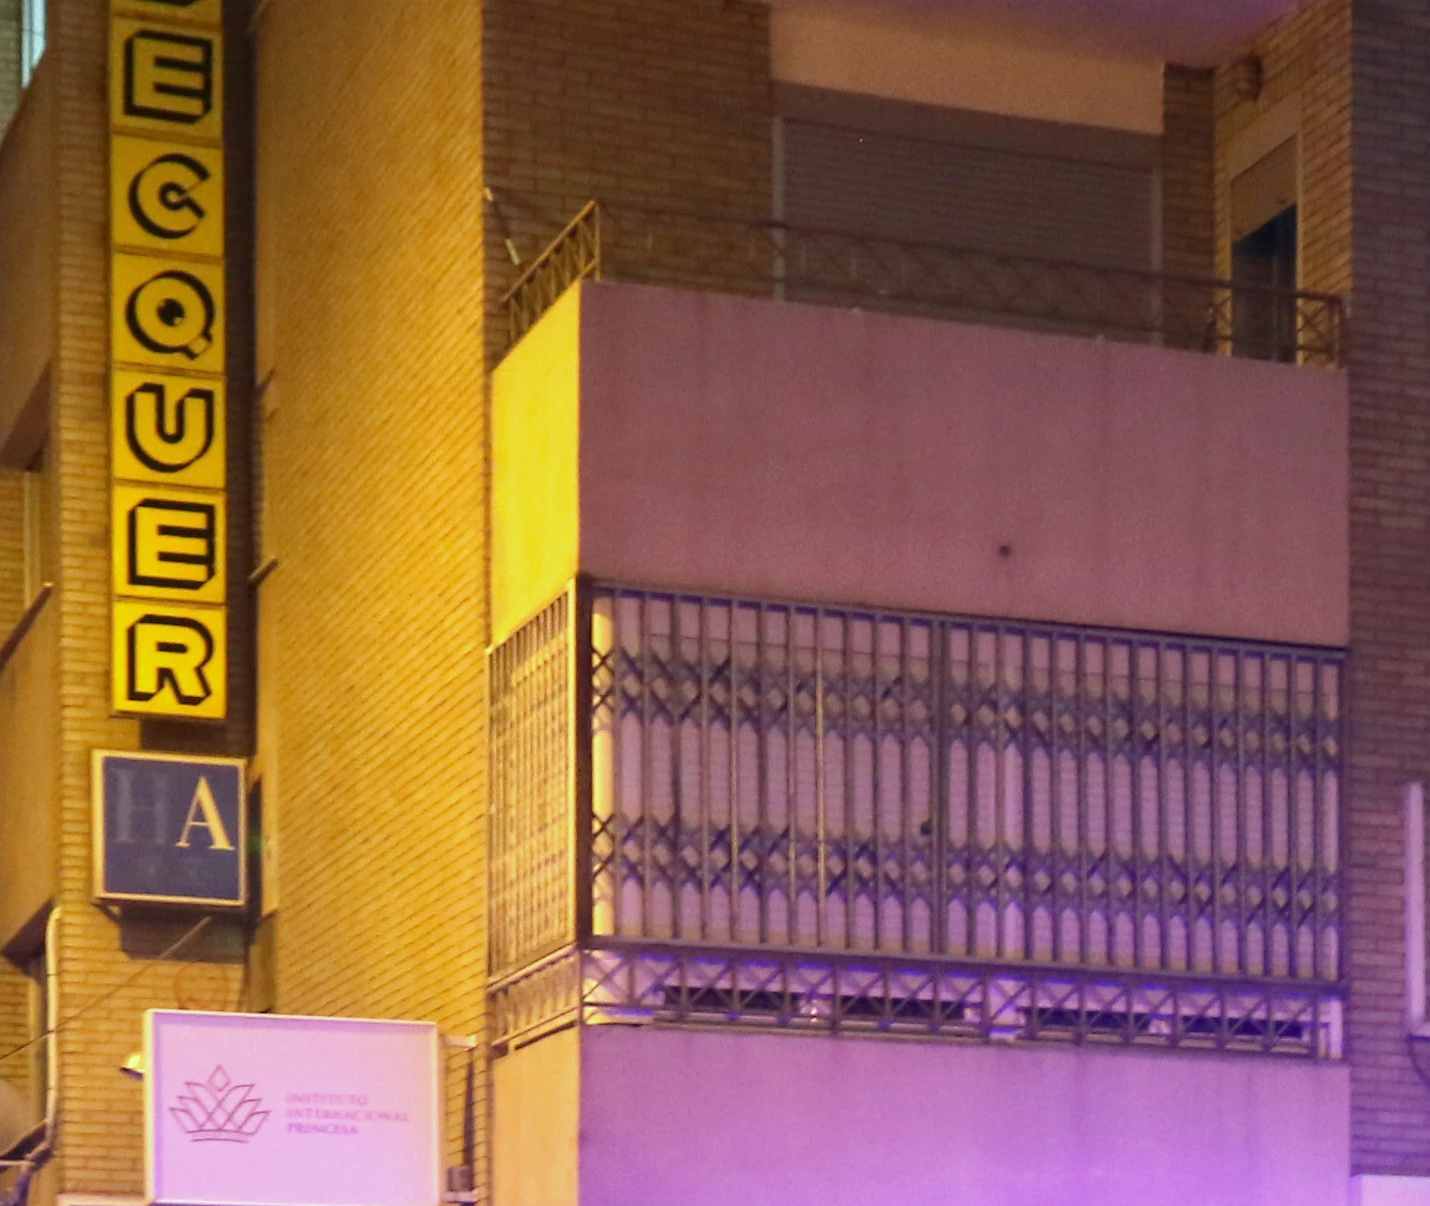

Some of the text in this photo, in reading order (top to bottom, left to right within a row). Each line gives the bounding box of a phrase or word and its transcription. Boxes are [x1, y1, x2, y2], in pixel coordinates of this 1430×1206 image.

[123, 0, 216, 707] ECQUER
[285, 1092, 370, 1107] INSTITUTO
[285, 1107, 409, 1122] INTERNACIONAL
[285, 1121, 359, 1135] PRINCESA
